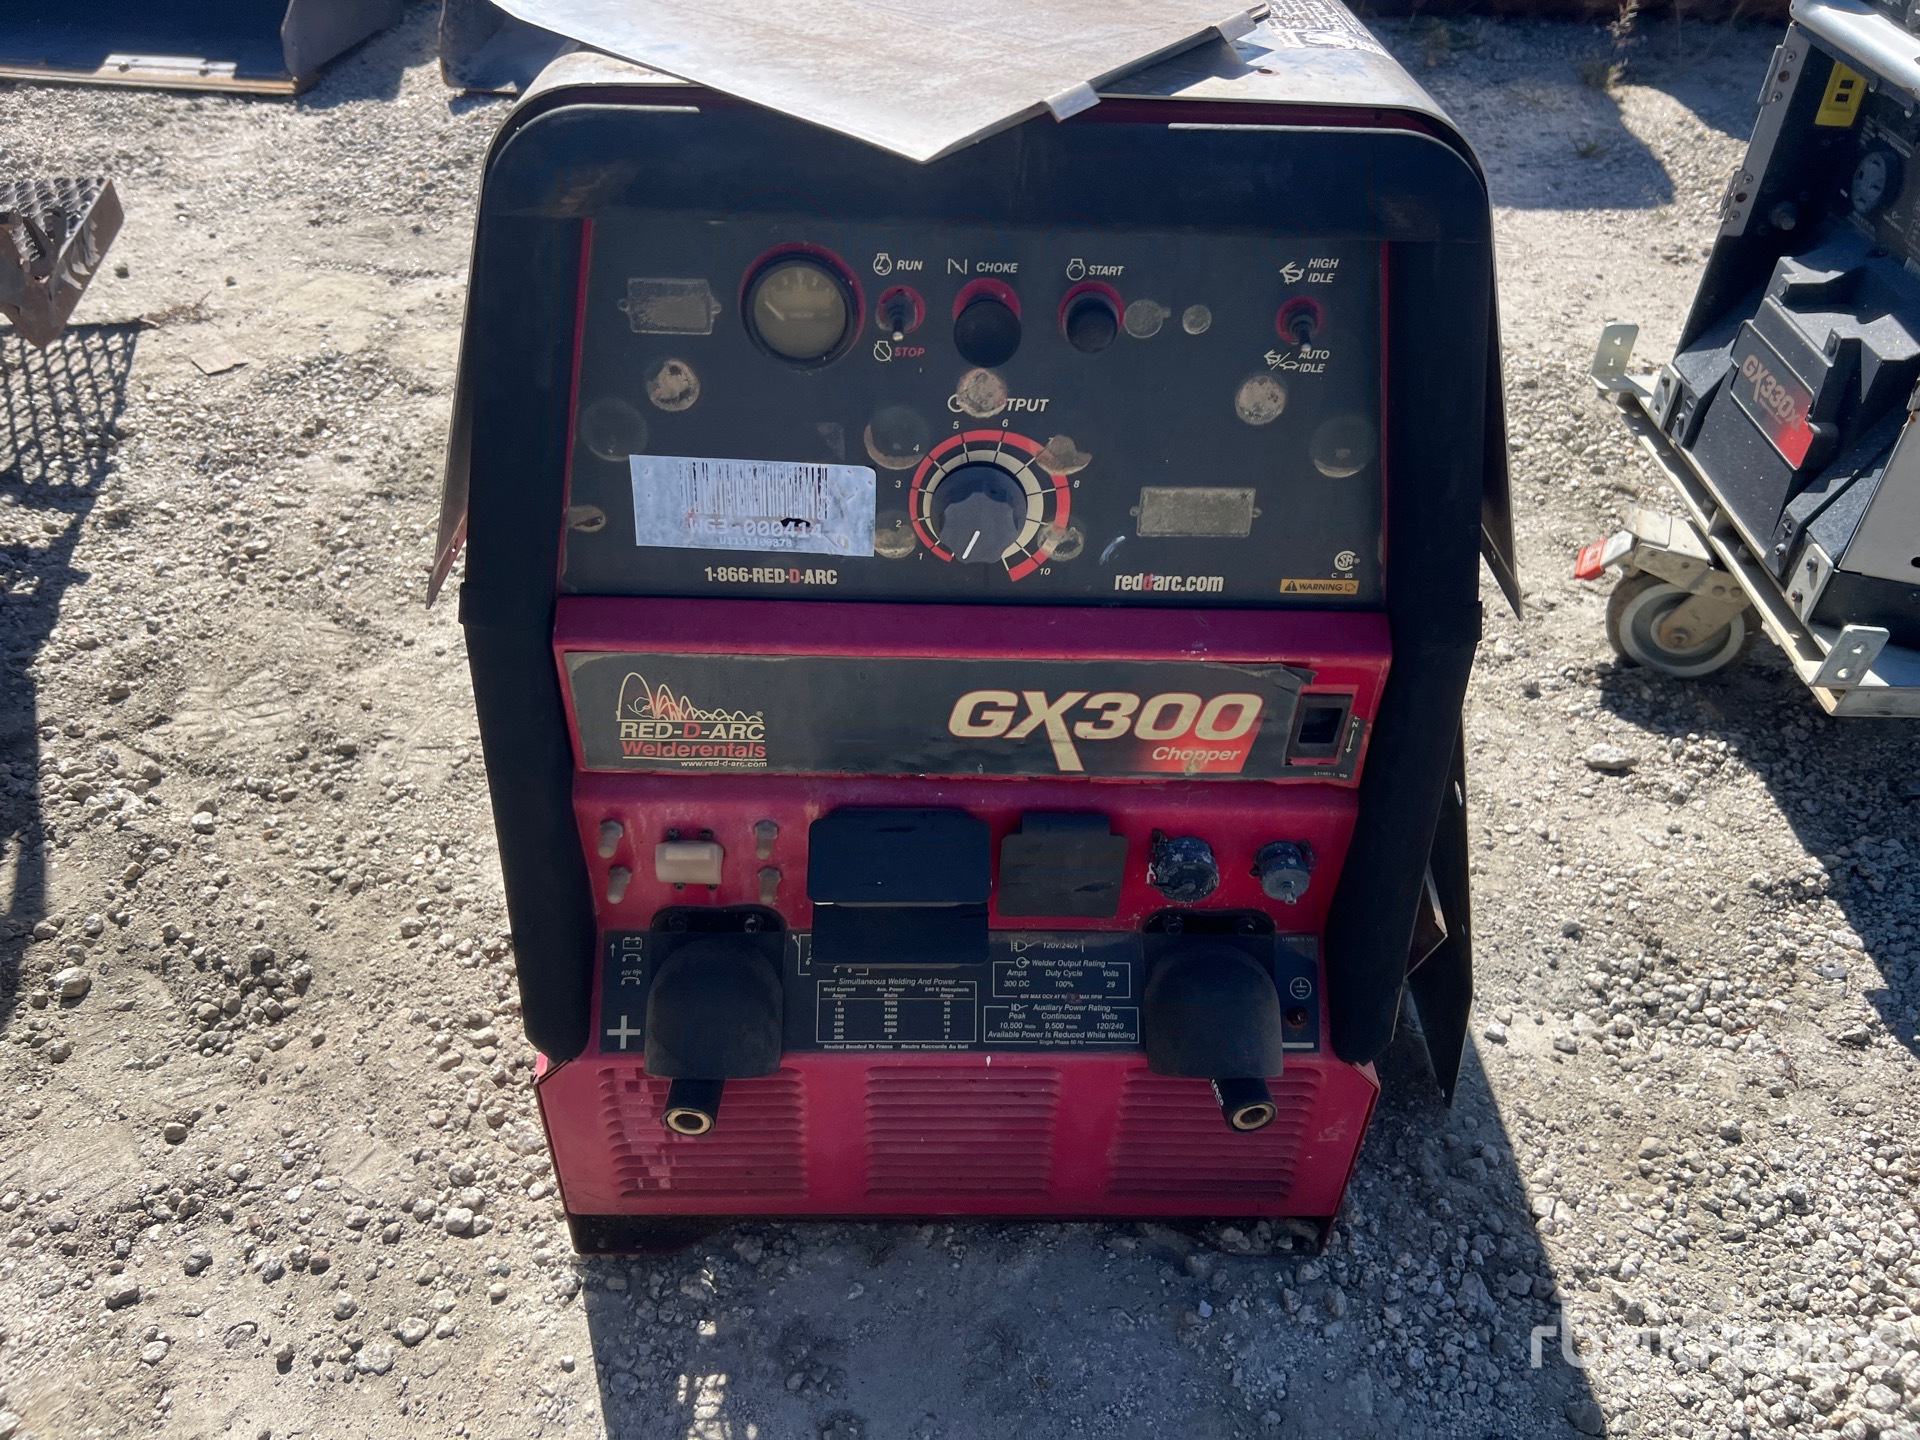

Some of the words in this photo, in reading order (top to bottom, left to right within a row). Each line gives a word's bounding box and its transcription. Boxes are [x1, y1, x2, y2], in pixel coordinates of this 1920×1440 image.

[897, 260, 923, 270] RUN
[976, 262, 1018, 273] CHOKE
[1308, 258, 1339, 269] HIGH
[1089, 265, 1124, 276] START
[1308, 273, 1335, 283] IDLE
[894, 347, 925, 357] STOP
[1299, 350, 1330, 360] AUTO
[1299, 364, 1325, 373] IDLE
[953, 421, 959, 429] 5
[1002, 419, 1008, 427] 6
[913, 444, 920, 452] 4
[896, 520, 902, 528] 2
[1040, 568, 1050, 576] 10
[1114, 574, 1224, 592] reddarc.com
[1299, 583, 1343, 591] WARNING
[620, 722, 765, 740] RED-D-ARC
[948, 689, 1264, 772] GX300
[622, 740, 767, 758] Welderentals
[1152, 745, 1241, 765] Chopper
[680, 760, 768, 768] www.red-d-arc.com
[1057, 960, 1082, 968] Output
[1083, 960, 1106, 968] Rating
[1045, 970, 1061, 978] Duty
[1062, 970, 1083, 978] Cycle
[888, 978, 916, 986] Welding
[1033, 1004, 1062, 1012] Auxiliary
[1107, 1032, 1136, 1040] Welding
